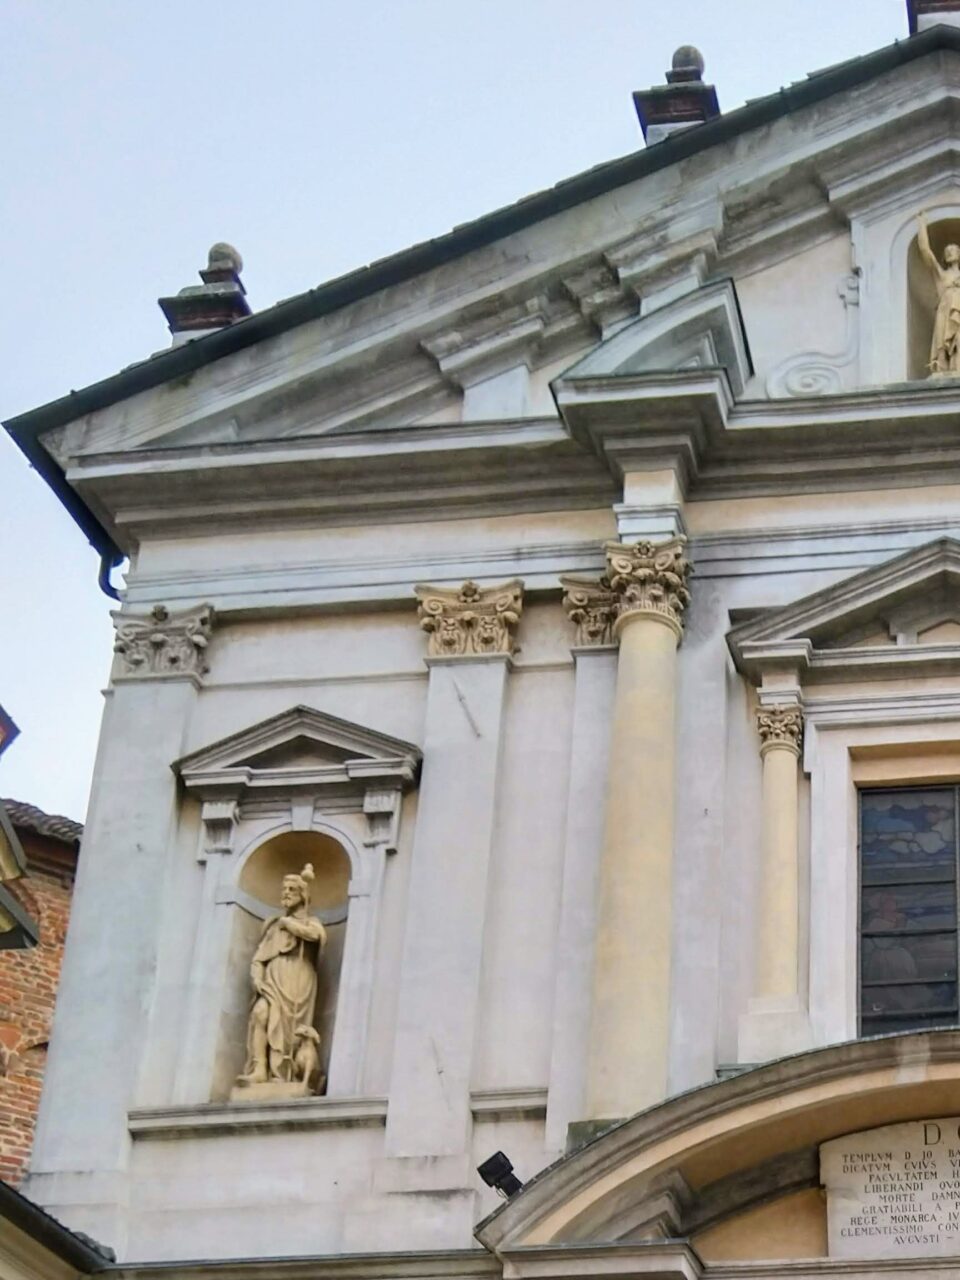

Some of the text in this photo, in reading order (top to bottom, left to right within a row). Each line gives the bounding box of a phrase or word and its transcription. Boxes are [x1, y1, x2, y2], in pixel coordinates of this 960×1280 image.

[842, 1152, 893, 1163] TEMPLVM
[904, 1151, 912, 1160] D
[842, 1163, 891, 1174] DICATVM
[904, 1161, 937, 1171] CVIVS
[868, 1171, 938, 1183] FACVLTATEM
[864, 1182, 924, 1194] LIBERANDI
[879, 1193, 916, 1203] MORTE
[862, 1203, 923, 1215] GRATIABILI
[935, 1203, 942, 1211] A
[850, 1216, 878, 1226] REGE
[890, 1213, 937, 1224] MONARCA
[840, 1225, 924, 1238] CLEMENTISSIMO
